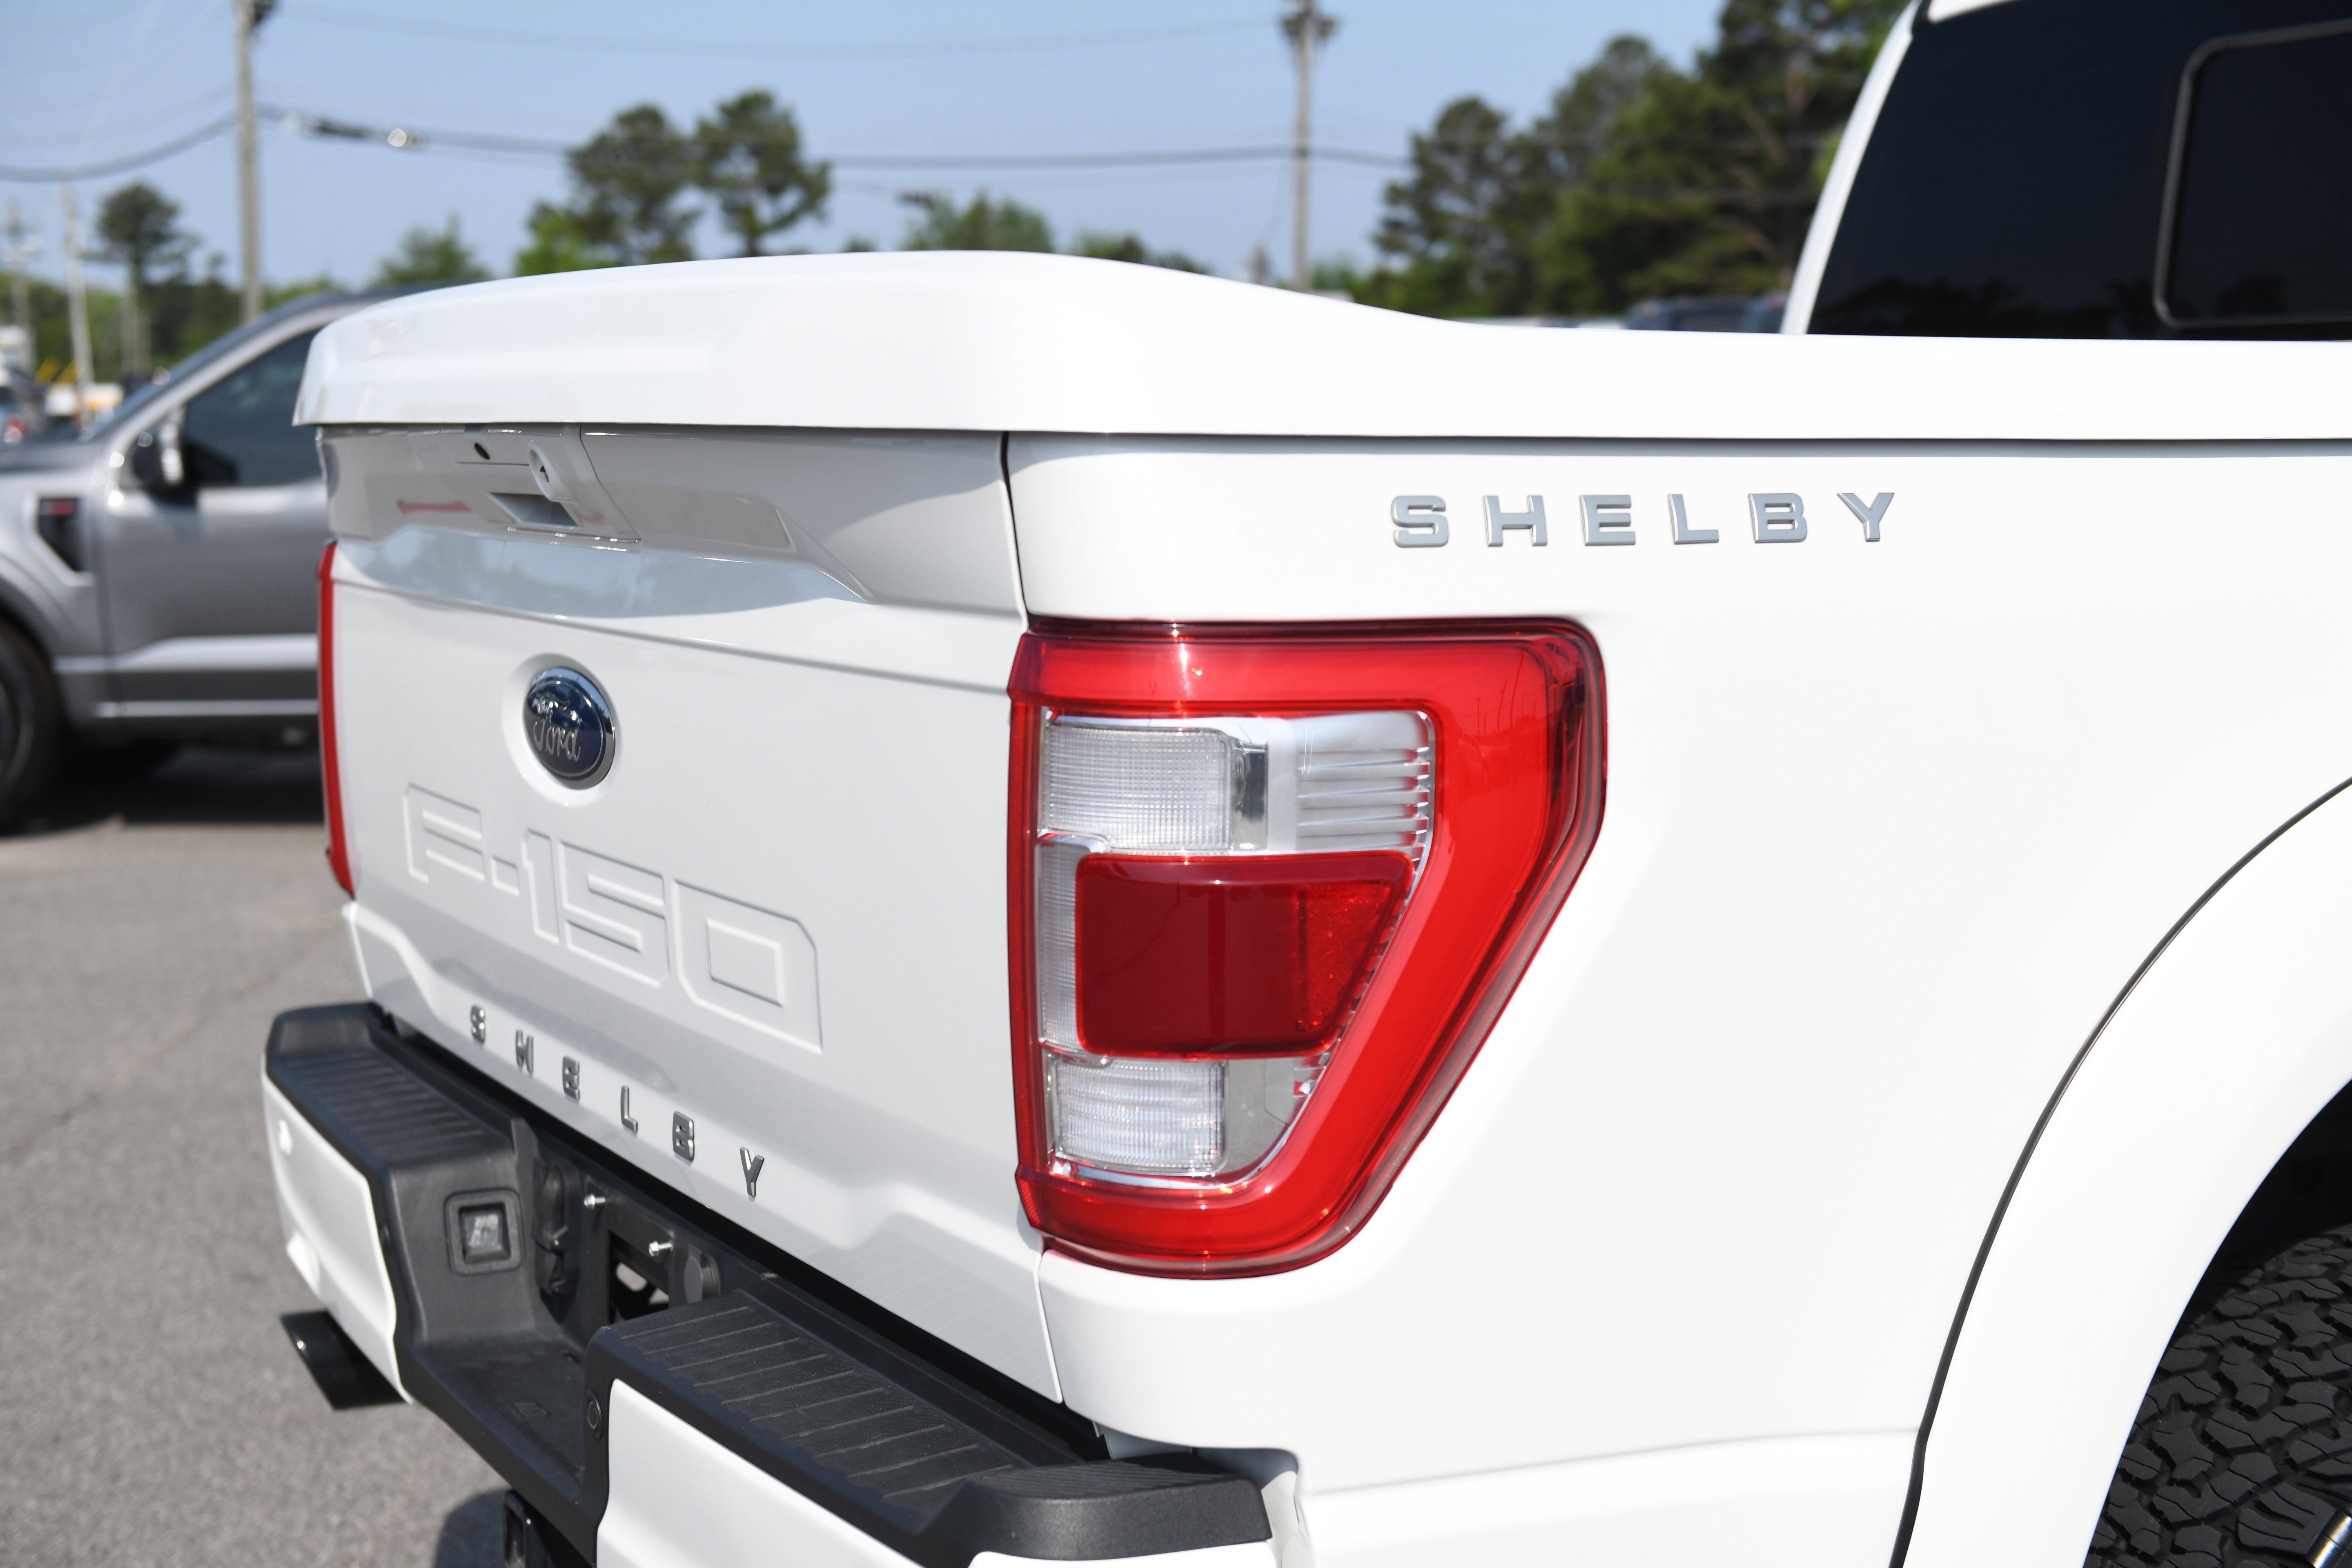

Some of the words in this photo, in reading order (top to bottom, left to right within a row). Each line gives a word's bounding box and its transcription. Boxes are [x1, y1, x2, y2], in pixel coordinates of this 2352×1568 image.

[1390, 492, 1895, 548] SHELBY
[533, 694, 583, 762] Ford
[403, 782, 823, 1054] F-150
[470, 1004, 765, 1197] SHELBY
